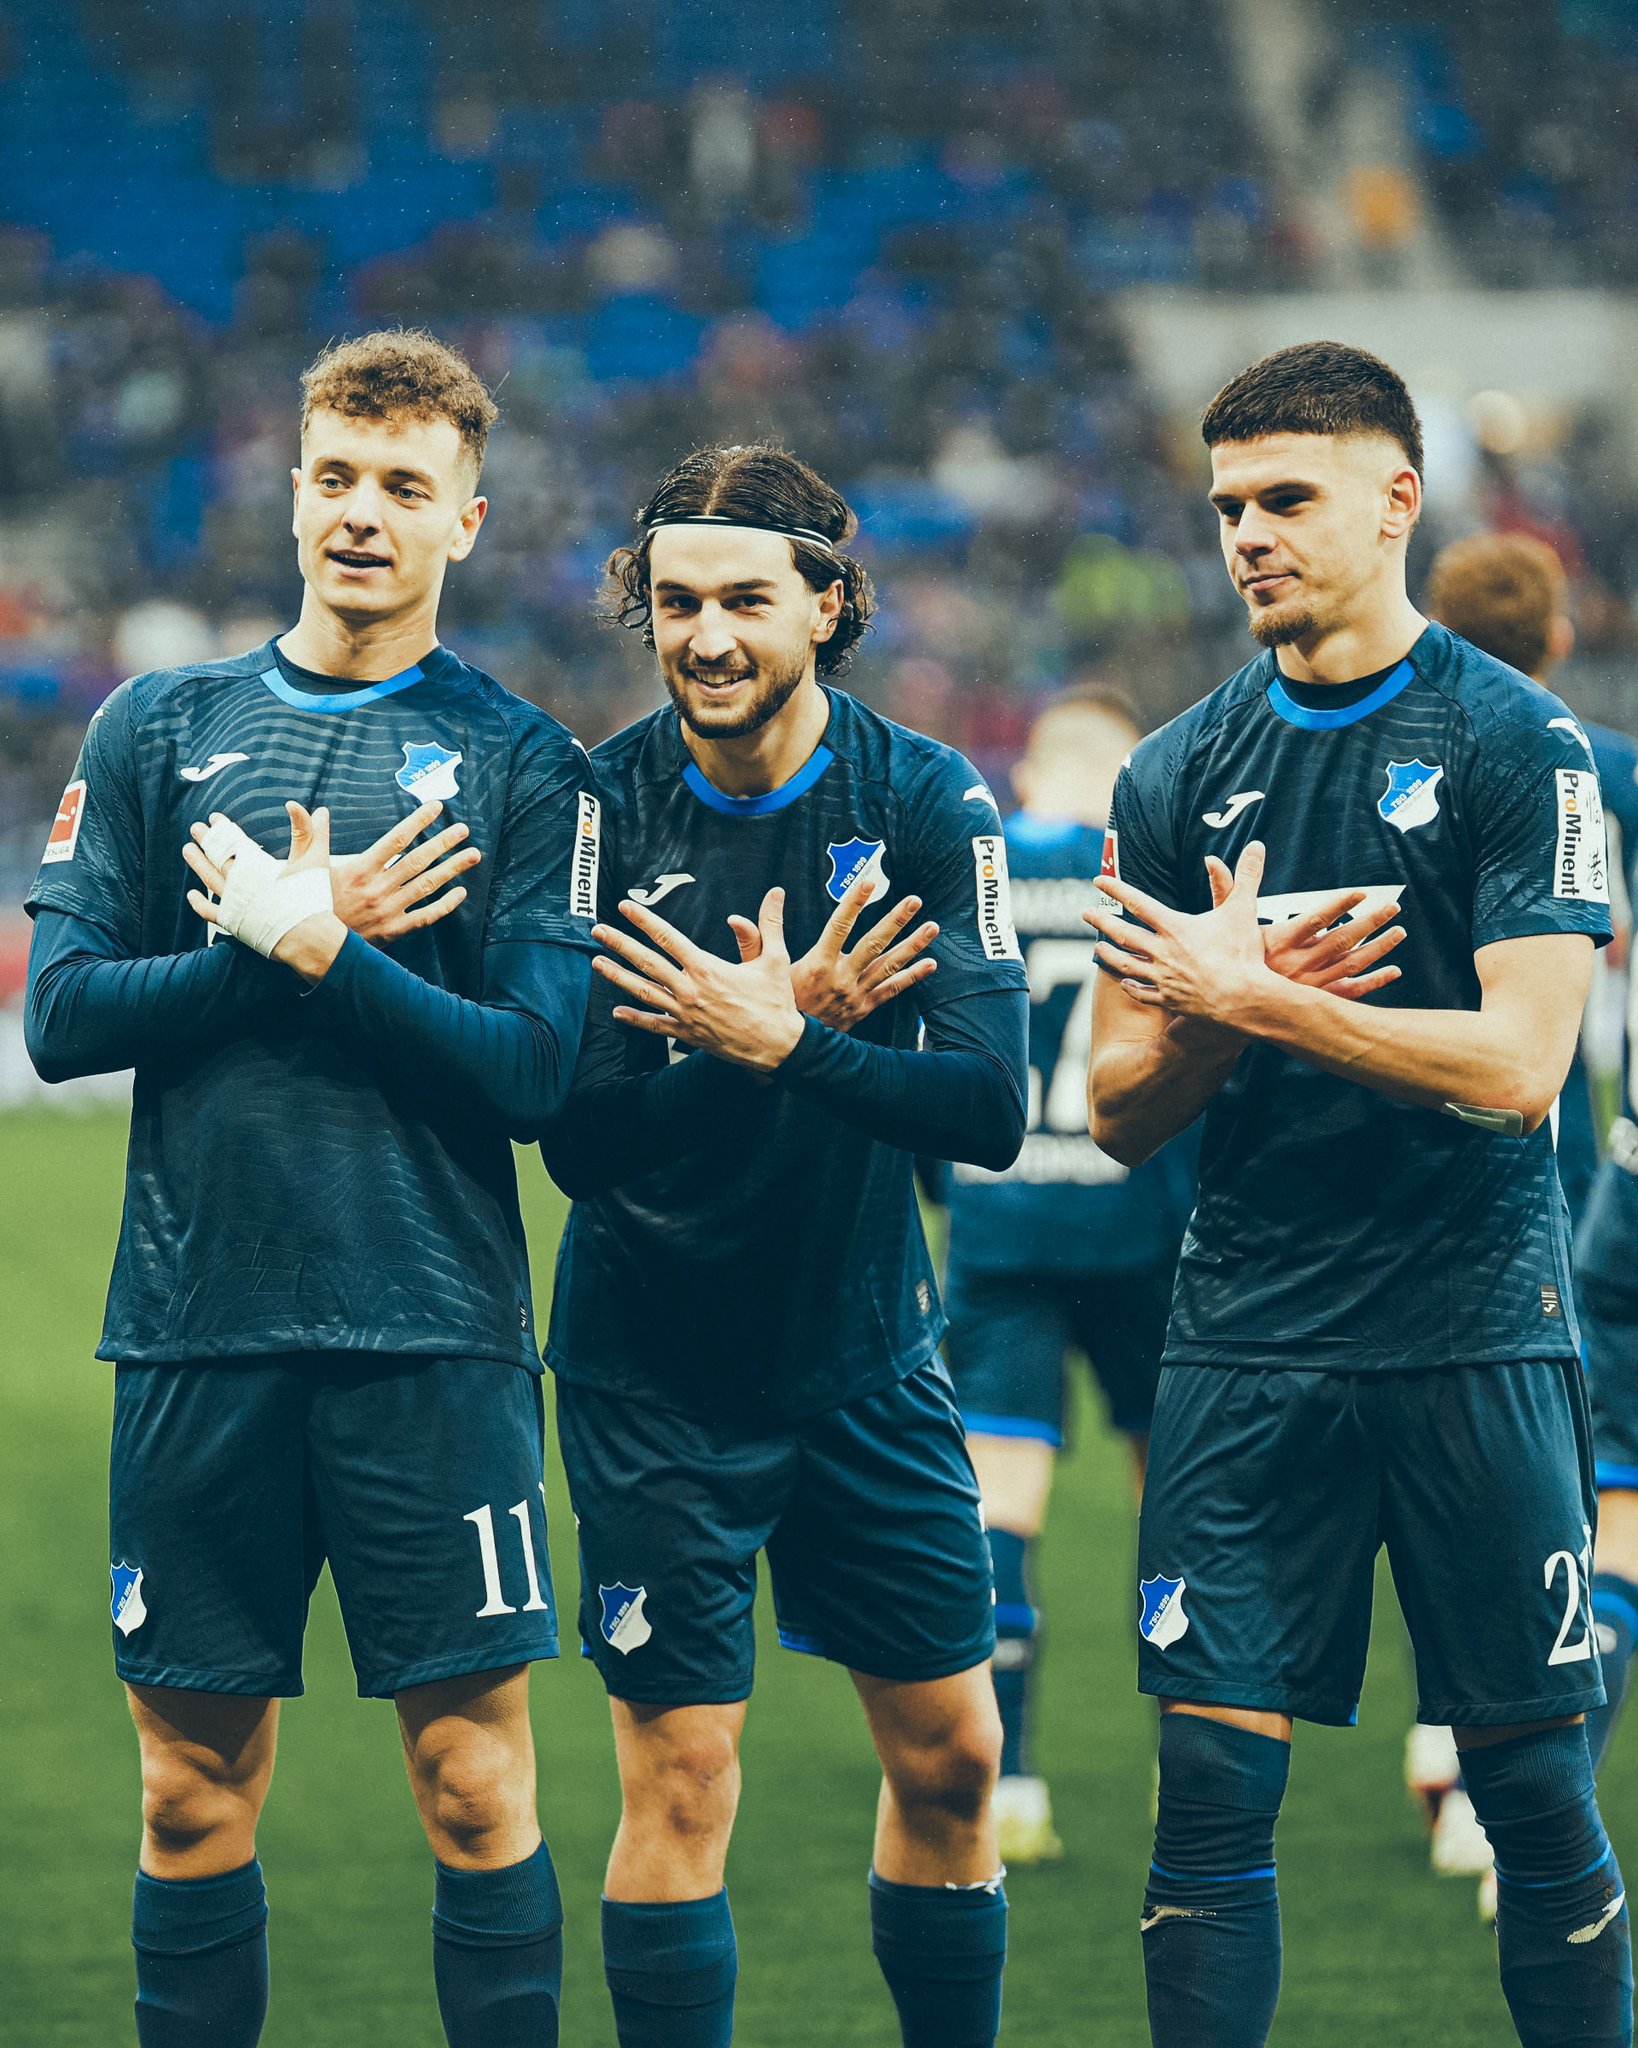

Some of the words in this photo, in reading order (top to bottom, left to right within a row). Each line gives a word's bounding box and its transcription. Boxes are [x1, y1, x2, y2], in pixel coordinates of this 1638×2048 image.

[409, 769, 426, 781] TSG
[1390, 793, 1407, 808] TSG
[576, 795, 596, 915] ProMinent
[1561, 772, 1581, 896] ProMinent
[840, 872, 855, 889] TSG
[978, 839, 1007, 956] ProMinent
[462, 1499, 549, 1618] 11
[1148, 1610, 1161, 1627] TSG
